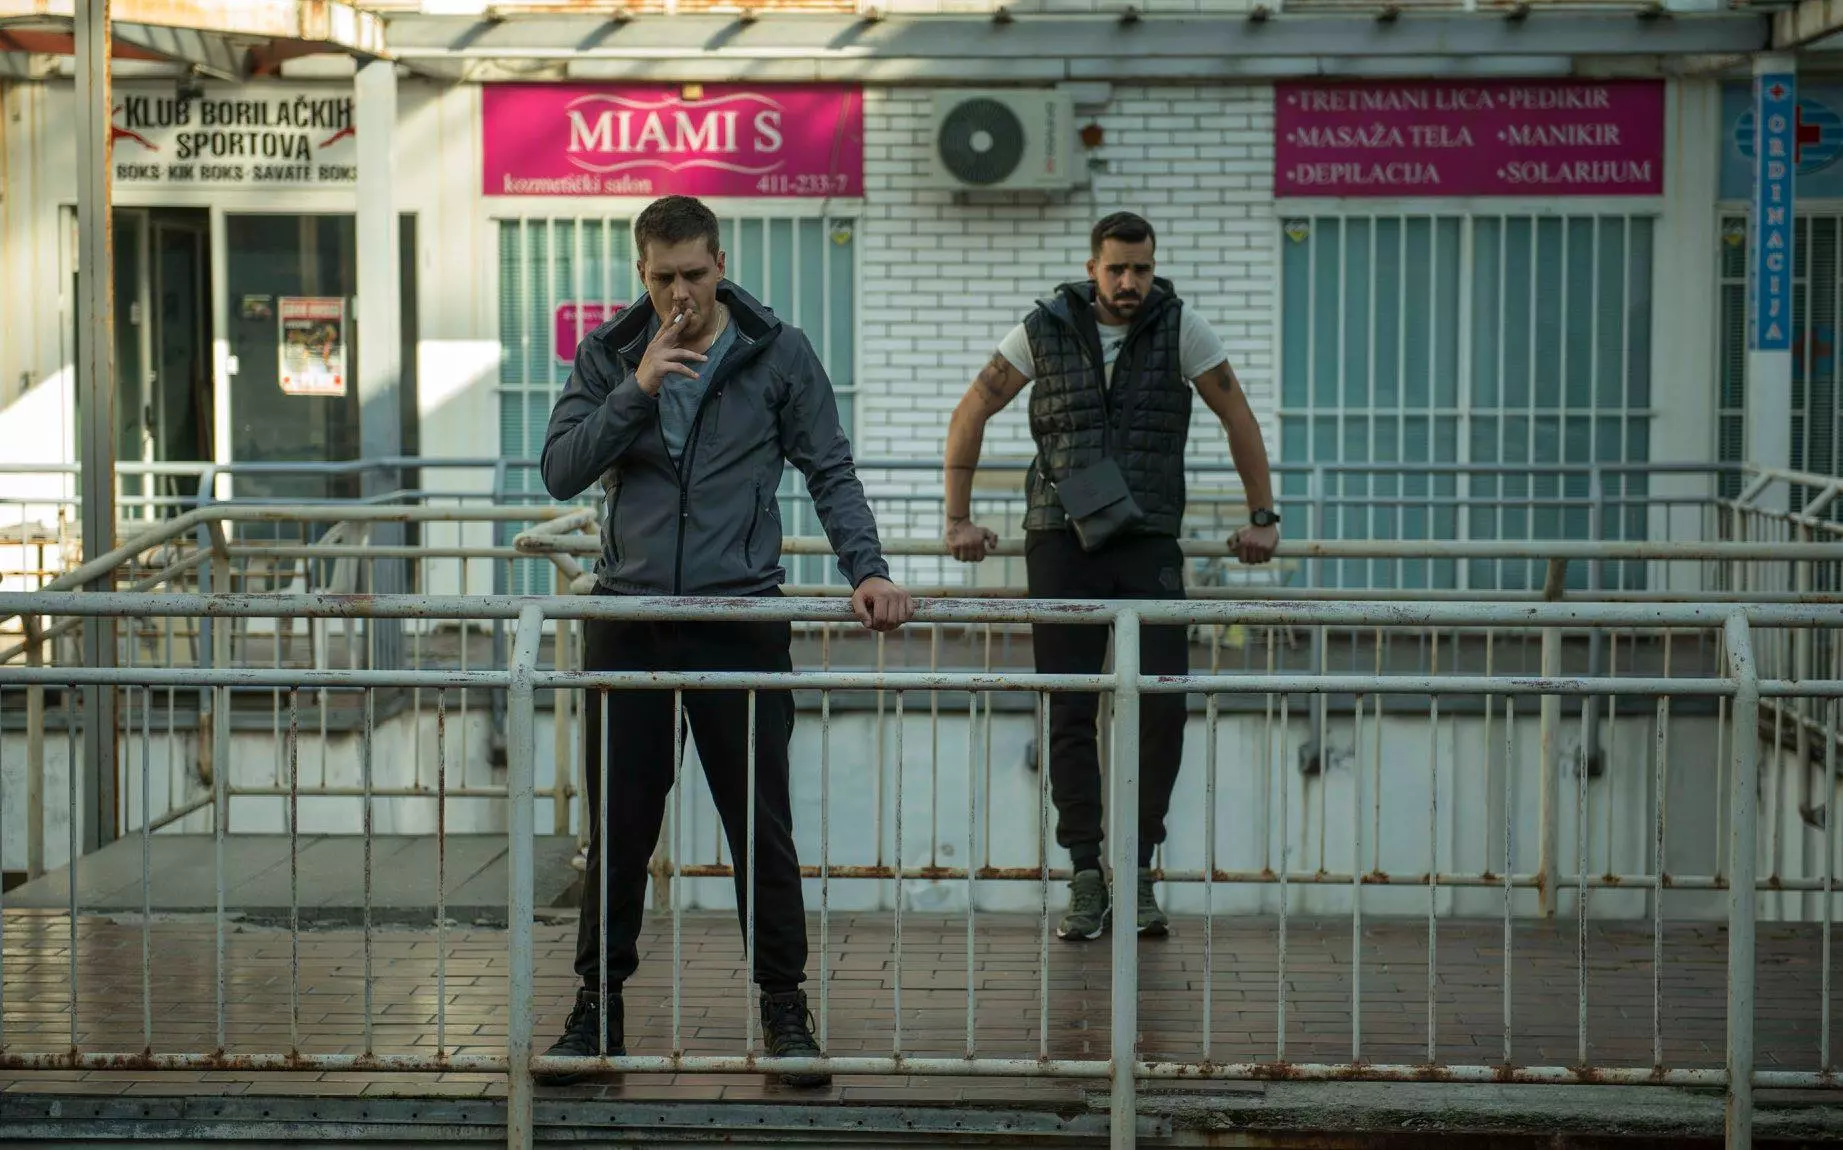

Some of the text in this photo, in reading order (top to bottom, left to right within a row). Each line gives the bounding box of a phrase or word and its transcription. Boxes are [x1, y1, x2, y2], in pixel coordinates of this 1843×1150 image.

[1299, 87, 1495, 111] TRETMANI LICA
[1508, 86, 1610, 109] PEDIKIR
[125, 93, 352, 129] KLUB BORILAČKIH
[566, 109, 783, 154] MIAMI S
[1296, 121, 1474, 148] MASAŽA TELA
[1507, 123, 1622, 147] MANIKIR
[176, 131, 312, 162] SPORTOVA
[116, 164, 161, 181] BOKS
[168, 164, 194, 181] KIK
[200, 164, 244, 181] BOKS
[252, 164, 312, 182] SAVATE
[604, 173, 653, 193] salon
[1295, 162, 1441, 185] DEPILACIJA
[1506, 160, 1653, 184] SOLARIJUM
[1764, 113, 1787, 341] ORDINACIJA
